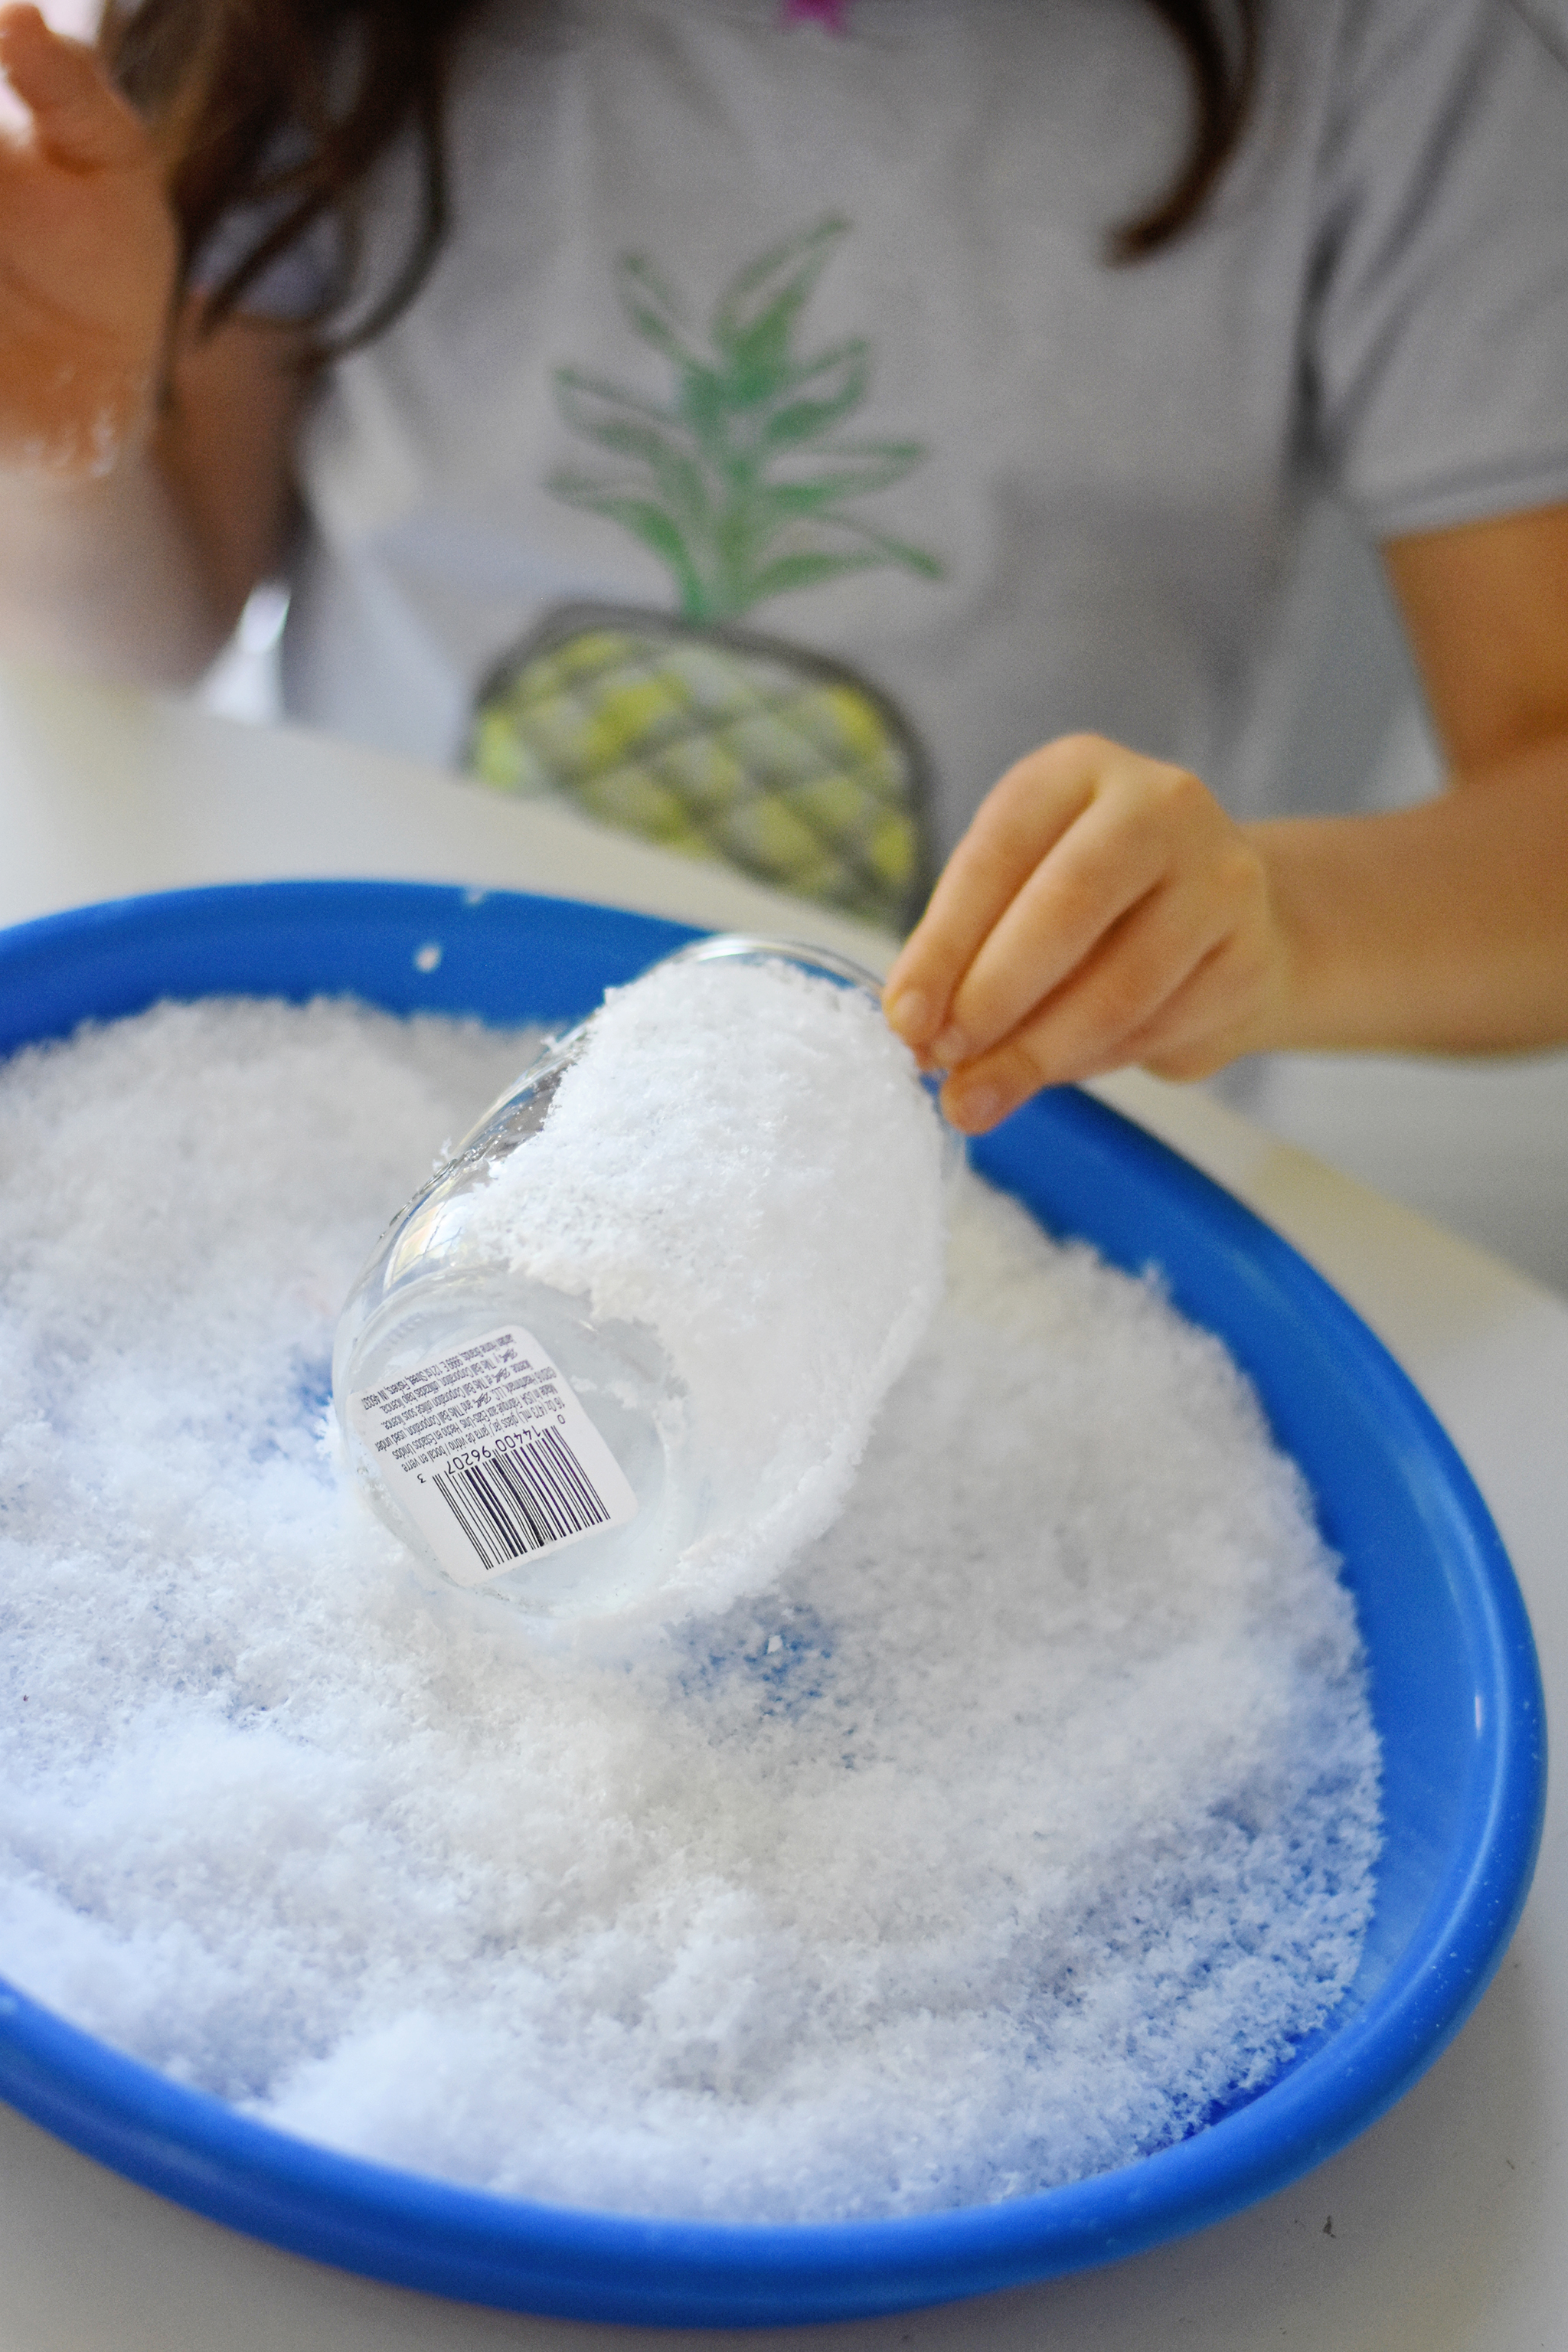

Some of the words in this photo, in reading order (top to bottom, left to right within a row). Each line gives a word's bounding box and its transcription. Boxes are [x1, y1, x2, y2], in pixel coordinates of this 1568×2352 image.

[446, 1355, 463, 1370] 9999
[469, 1362, 485, 1376] Ball
[423, 1364, 443, 1379] 121st
[436, 1364, 474, 1389] Corporation,
[384, 1377, 411, 1395] Fishers,
[472, 1377, 489, 1390] TMs
[484, 1375, 493, 1386] et
[377, 1390, 390, 1401] IN
[397, 1386, 419, 1405] bajo
[413, 1380, 441, 1401] utilizadas
[431, 1387, 466, 1406] Corporation
[462, 1382, 477, 1396] Ball
[539, 1383, 558, 1397] Made
[361, 1393, 381, 1410] 46037
[379, 1397, 406, 1415] licencia.
[496, 1394, 523, 1416] Fabriqué
[520, 1391, 537, 1406] USA
[554, 1396, 565, 1410] 16
[401, 1408, 418, 1421] sous
[415, 1400, 434, 1417] utilisé
[447, 1405, 466, 1418] TMs
[460, 1400, 473, 1414] and
[485, 1406, 499, 1417] aux
[515, 1406, 532, 1423] mL)
[527, 1400, 547, 1419] (473
[381, 1415, 406, 1430] licence.
[437, 1410, 452, 1424] Ball
[501, 1410, 519, 1428] glass
[403, 1414, 441, 1436] Corporation,
[441, 1422, 462, 1437] Hecho
[473, 1423, 492, 1439] jarra
[489, 1418, 505, 1432] jar
[390, 1429, 407, 1446] used
[412, 1433, 438, 1449] Estados
[433, 1430, 443, 1440] en
[466, 1432, 476, 1445] de
[495, 1426, 541, 1452] 14400
[374, 1436, 394, 1452] under
[392, 1443, 416, 1460] Unidos
[448, 1436, 469, 1452] vidrio
[417, 1453, 429, 1464] en
[426, 1446, 449, 1463] bocal
[446, 1445, 492, 1475] 96207
[401, 1458, 420, 1472] verre
